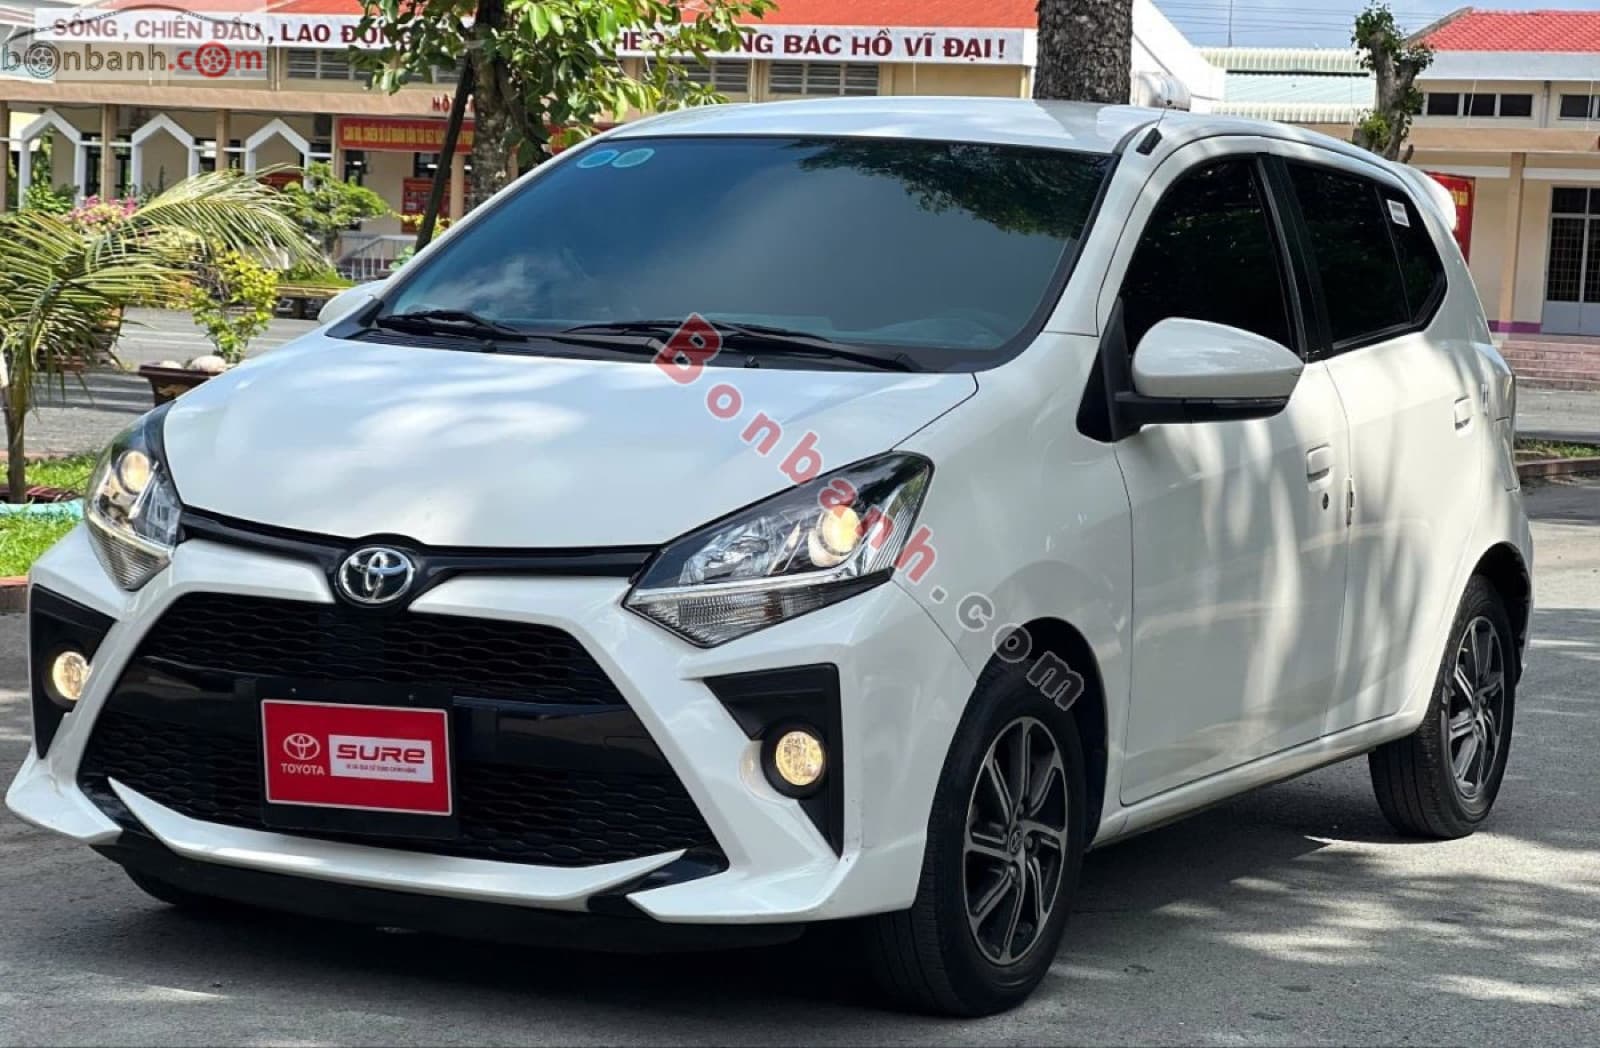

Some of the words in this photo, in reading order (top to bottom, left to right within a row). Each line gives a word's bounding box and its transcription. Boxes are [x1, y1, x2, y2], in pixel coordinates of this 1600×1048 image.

[281, 24, 331, 43] LAO
[783, 29, 841, 54] BÁC
[851, 27, 893, 56] HỒ
[904, 32, 936, 57] VĨ
[281, 763, 325, 776] TOYOTA
